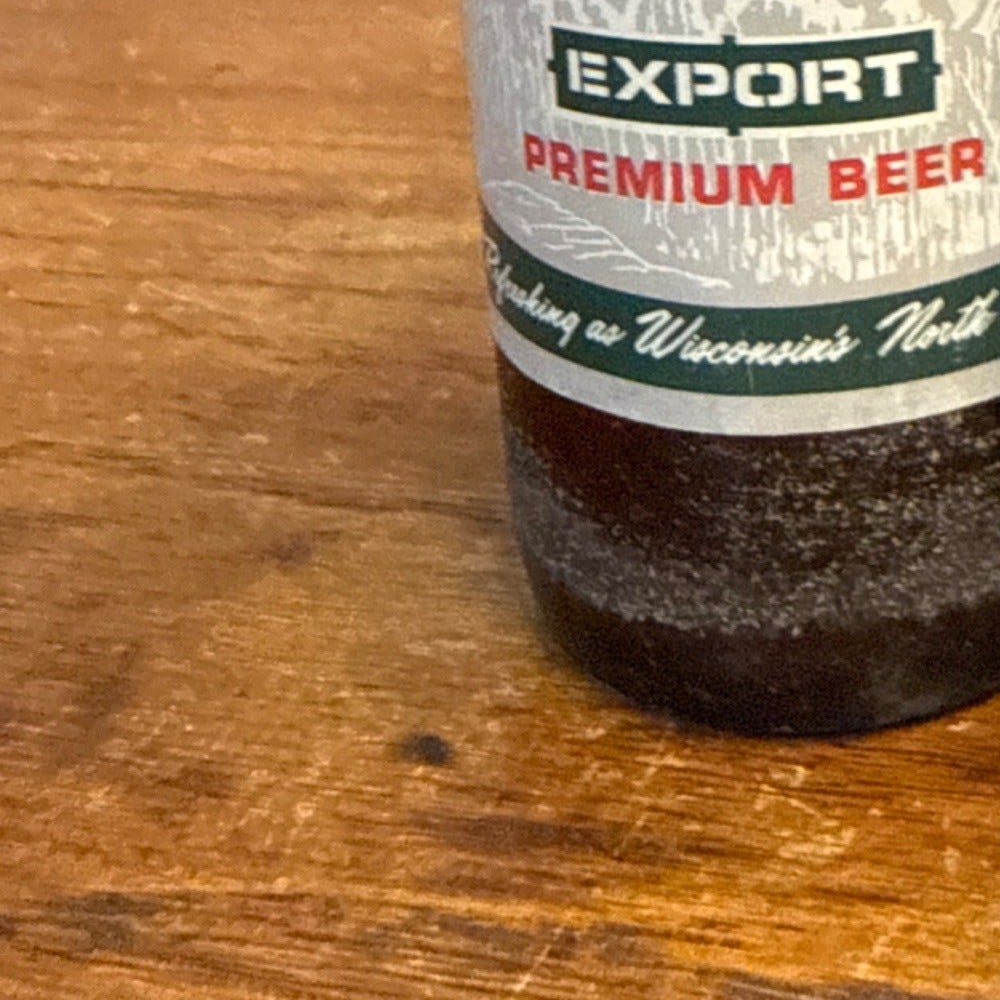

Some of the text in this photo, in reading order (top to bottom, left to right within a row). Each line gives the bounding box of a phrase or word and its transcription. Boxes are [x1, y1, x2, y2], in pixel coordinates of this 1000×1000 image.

[565, 48, 919, 108] EXPORT
[524, 133, 985, 207] PREMIUM BEER
[584, 319, 628, 347] as
[633, 308, 862, 367] Wisconsin's
[875, 288, 1000, 357] North
